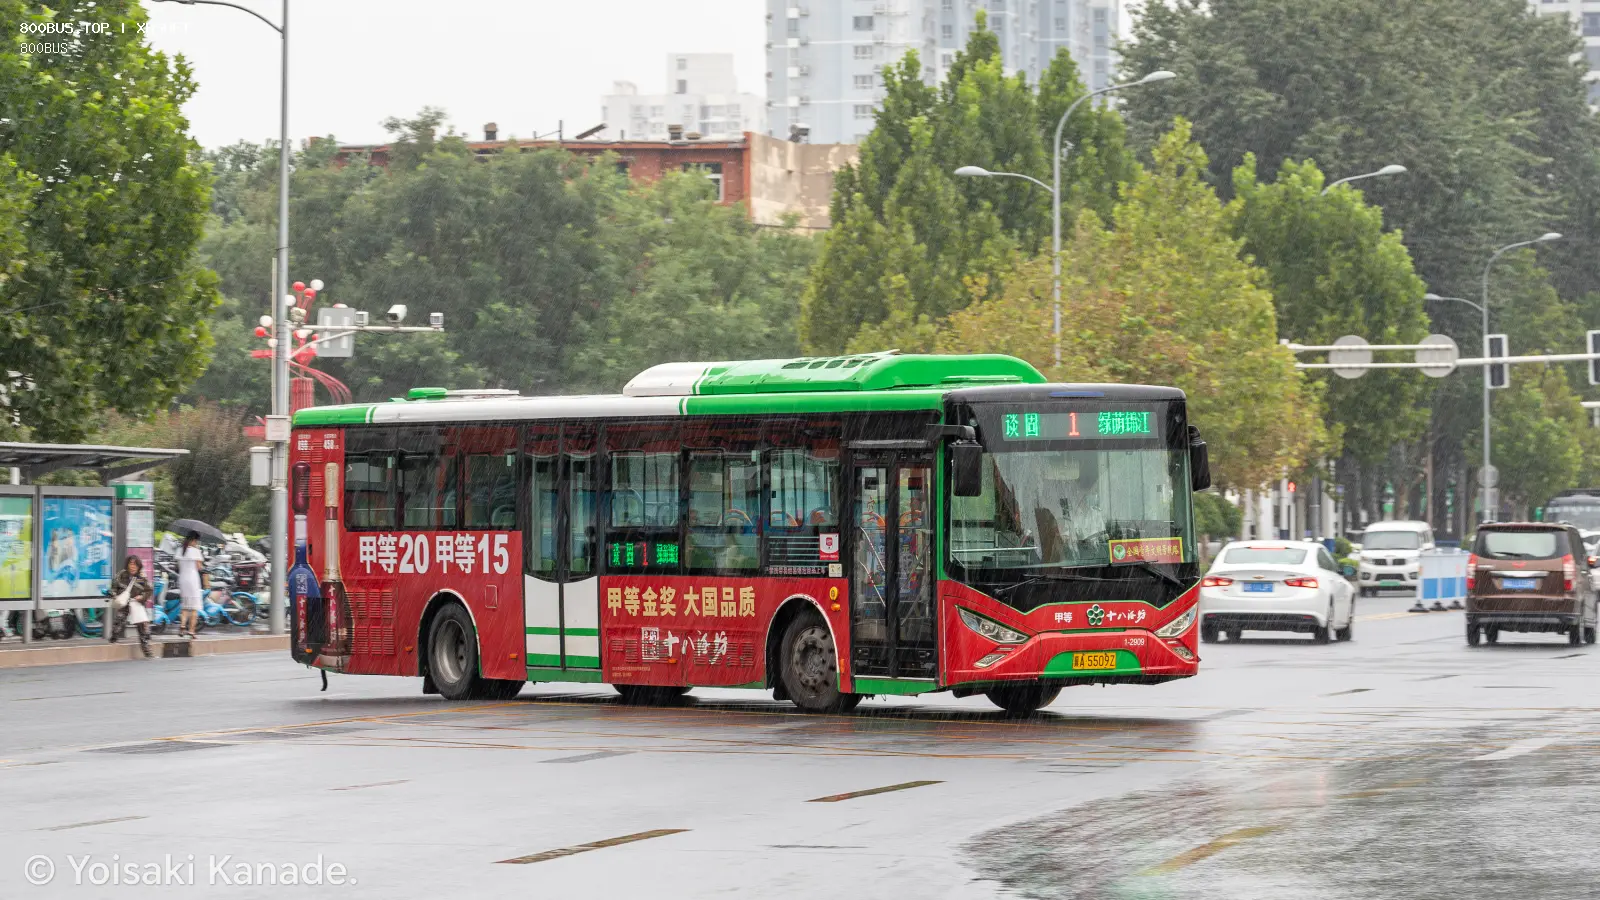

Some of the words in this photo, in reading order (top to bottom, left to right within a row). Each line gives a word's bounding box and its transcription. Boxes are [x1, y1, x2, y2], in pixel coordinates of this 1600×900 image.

[1069, 412, 1080, 436] 1
[359, 533, 430, 574] 甲等20
[435, 533, 510, 574] 甲等15
[607, 586, 676, 617] 甲等金奖
[683, 586, 756, 617] 大国品质
[1054, 612, 1073, 623] 甲等
[1124, 638, 1145, 646] 1-2909
